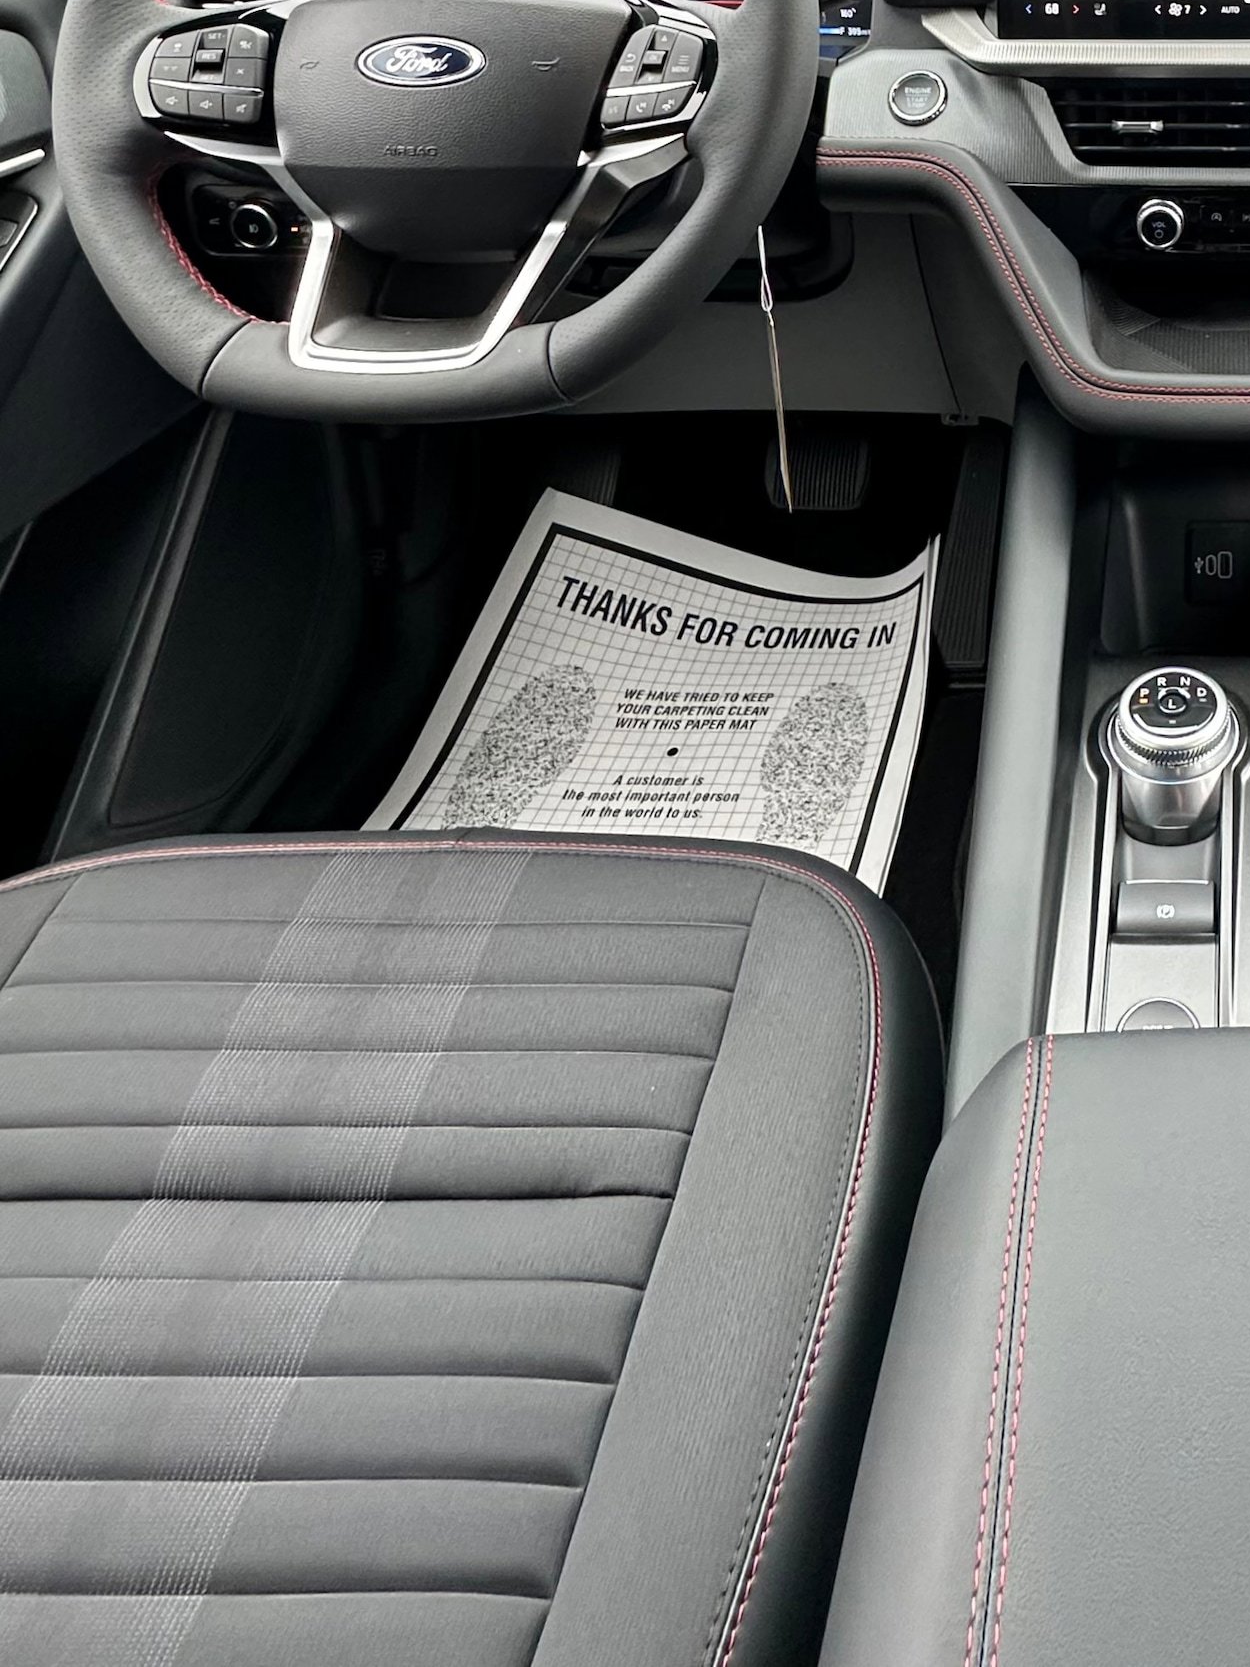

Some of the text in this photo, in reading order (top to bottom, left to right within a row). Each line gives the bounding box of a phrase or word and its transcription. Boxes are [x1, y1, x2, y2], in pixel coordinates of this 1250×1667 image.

[1185, 4, 1191, 14] 7
[1221, 6, 1240, 14] AUTO
[385, 45, 452, 73] Ford
[383, 145, 438, 157] AIRBAG
[1151, 221, 1166, 229] VOL
[557, 576, 897, 649] THANKS FOR COMING IN
[1157, 677, 1167, 686] R
[1180, 676, 1191, 686] N
[624, 689, 775, 702] WE HAVE TRIED TO KEEP
[1140, 688, 1150, 697] P
[1197, 688, 1207, 697] D
[616, 703, 770, 716] YOUR CARPETING CLEAN
[1168, 699, 1177, 709] L
[615, 718, 758, 730] WITH THIS PAPER MAT
[613, 775, 705, 786] A customer is
[562, 789, 740, 804] the most important person
[581, 806, 703, 818] in the world to us.
